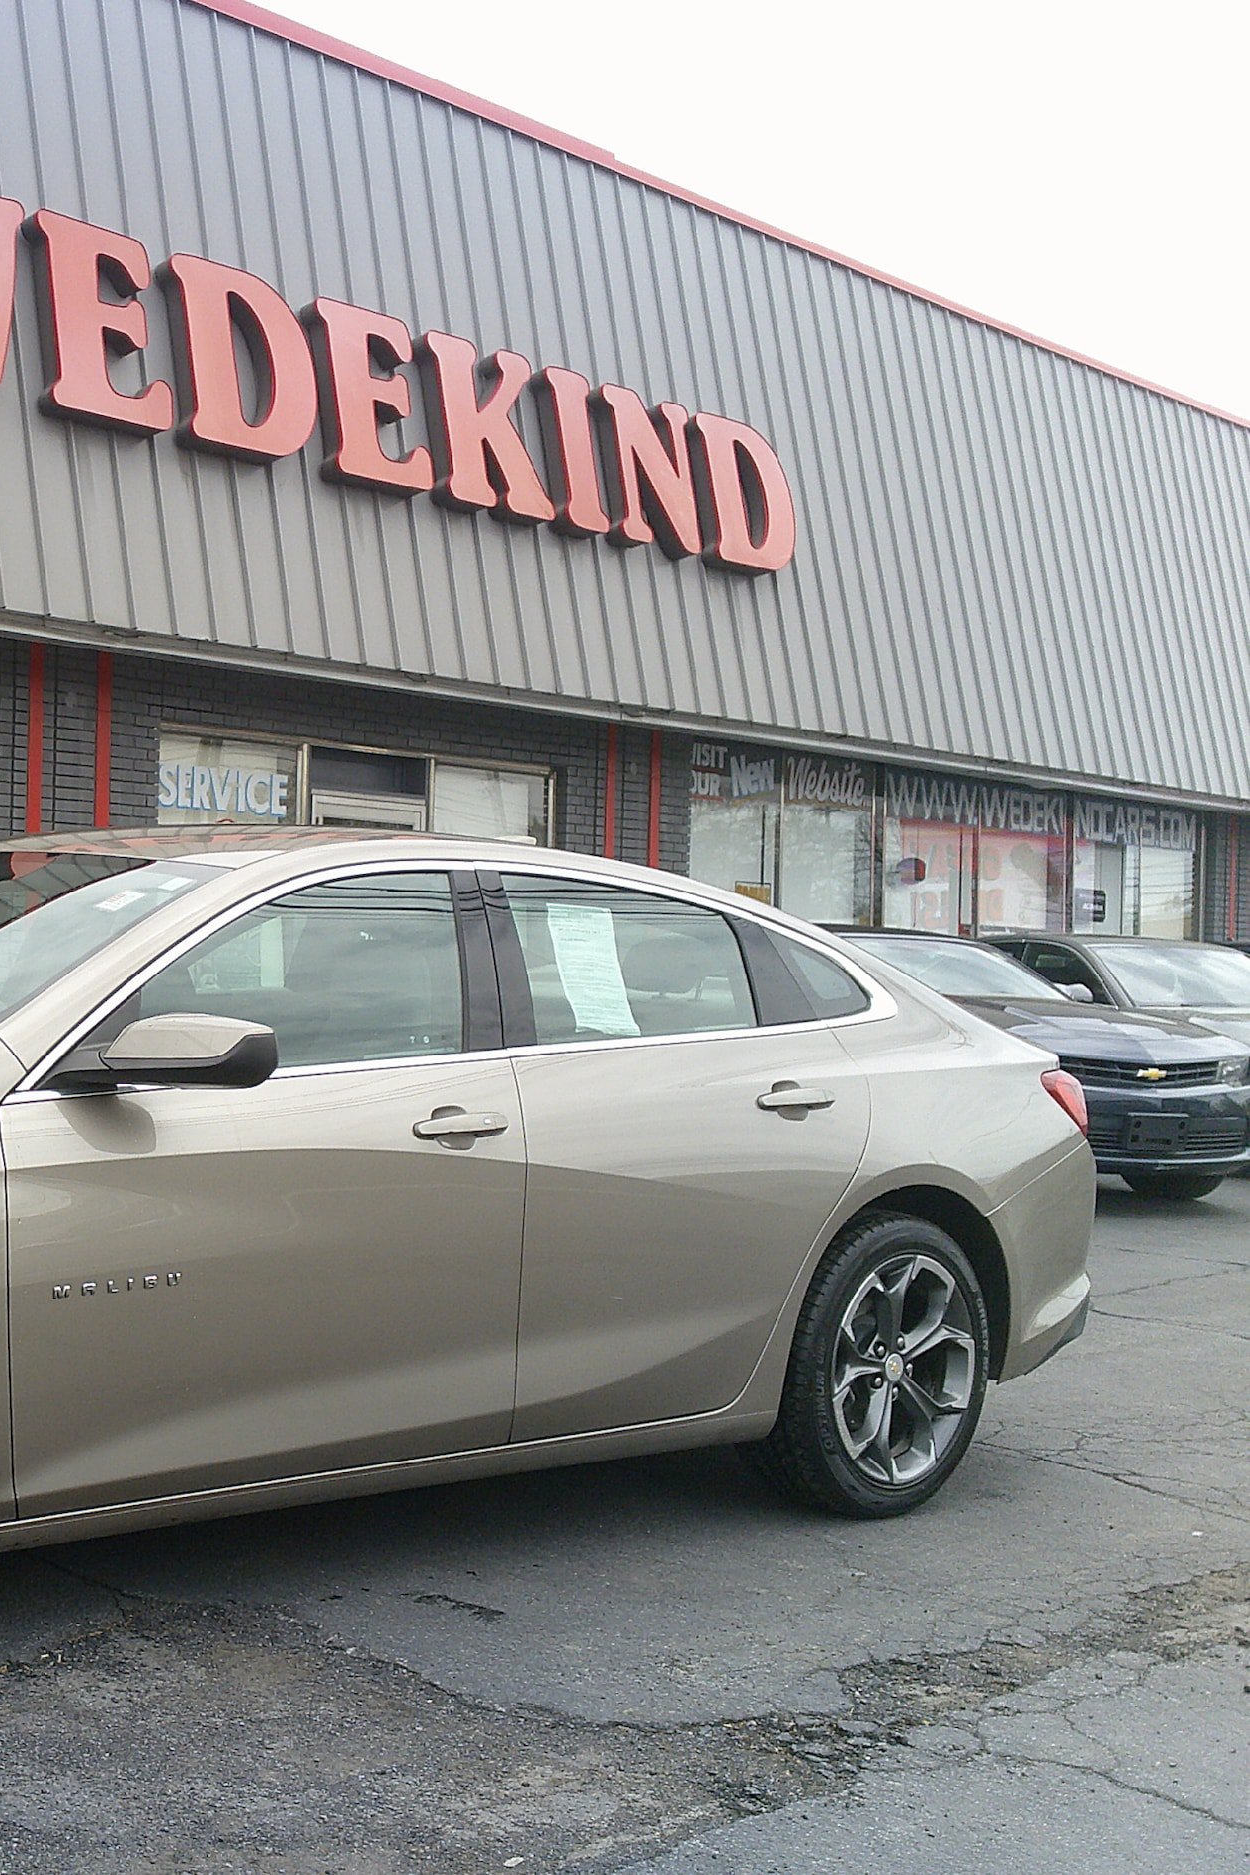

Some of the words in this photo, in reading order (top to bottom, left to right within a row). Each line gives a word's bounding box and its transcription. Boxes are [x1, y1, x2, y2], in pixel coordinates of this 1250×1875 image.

[158, 762, 288, 818] SERVICE
[730, 754, 775, 797] New
[52, 1272, 182, 1299] MALIBU
